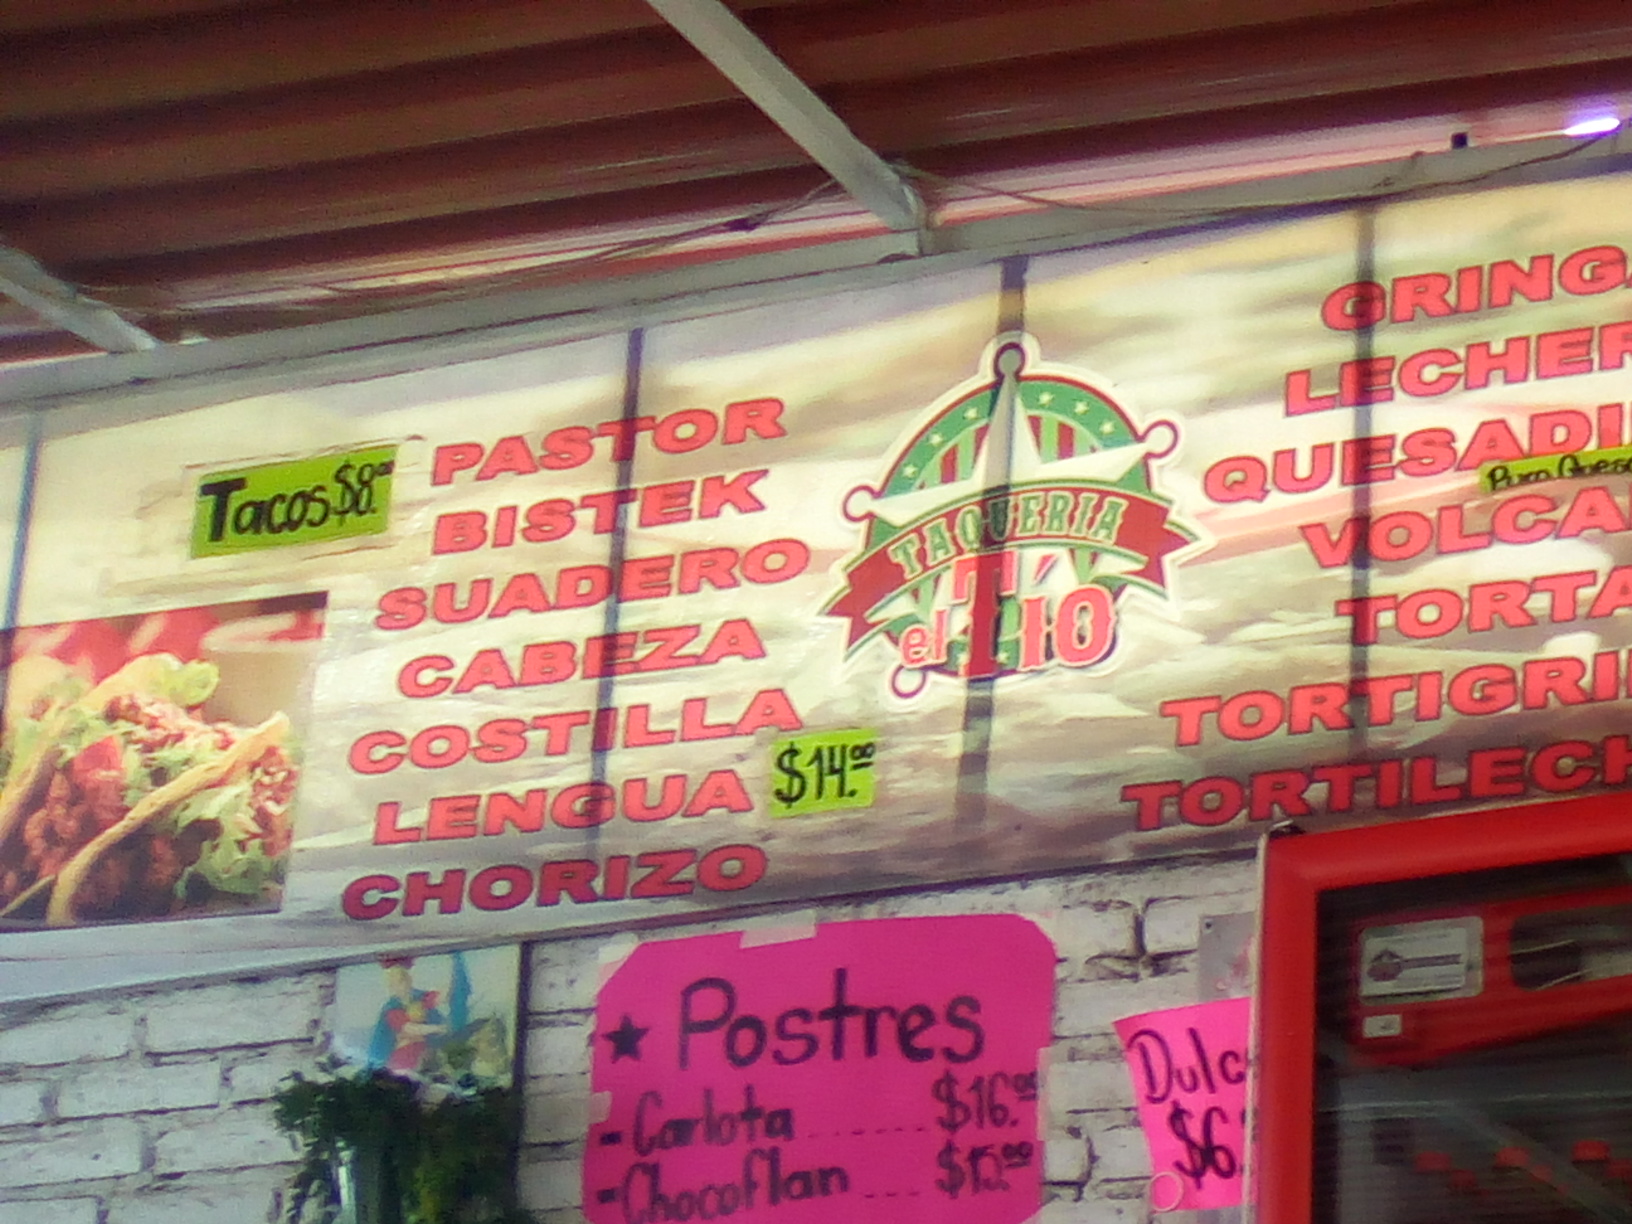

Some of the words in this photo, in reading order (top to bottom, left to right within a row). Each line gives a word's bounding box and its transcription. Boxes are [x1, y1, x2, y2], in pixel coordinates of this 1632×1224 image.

[430, 397, 788, 487] PASTOR
[200, 477, 331, 542] Tacos
[430, 468, 770, 556] BISTEK
[890, 491, 1129, 579] TAQUERIA
[373, 537, 812, 632] SUADERO
[396, 618, 767, 699] CABEZA
[900, 608, 948, 669] el
[347, 689, 803, 776] COSTILLA
[371, 768, 754, 847] LENGUA
[340, 843, 769, 922] CHORIZO
[678, 967, 986, 1069] Postres
[1127, 1027, 1249, 1104] Dulc
[634, 1084, 795, 1156] Carlota
